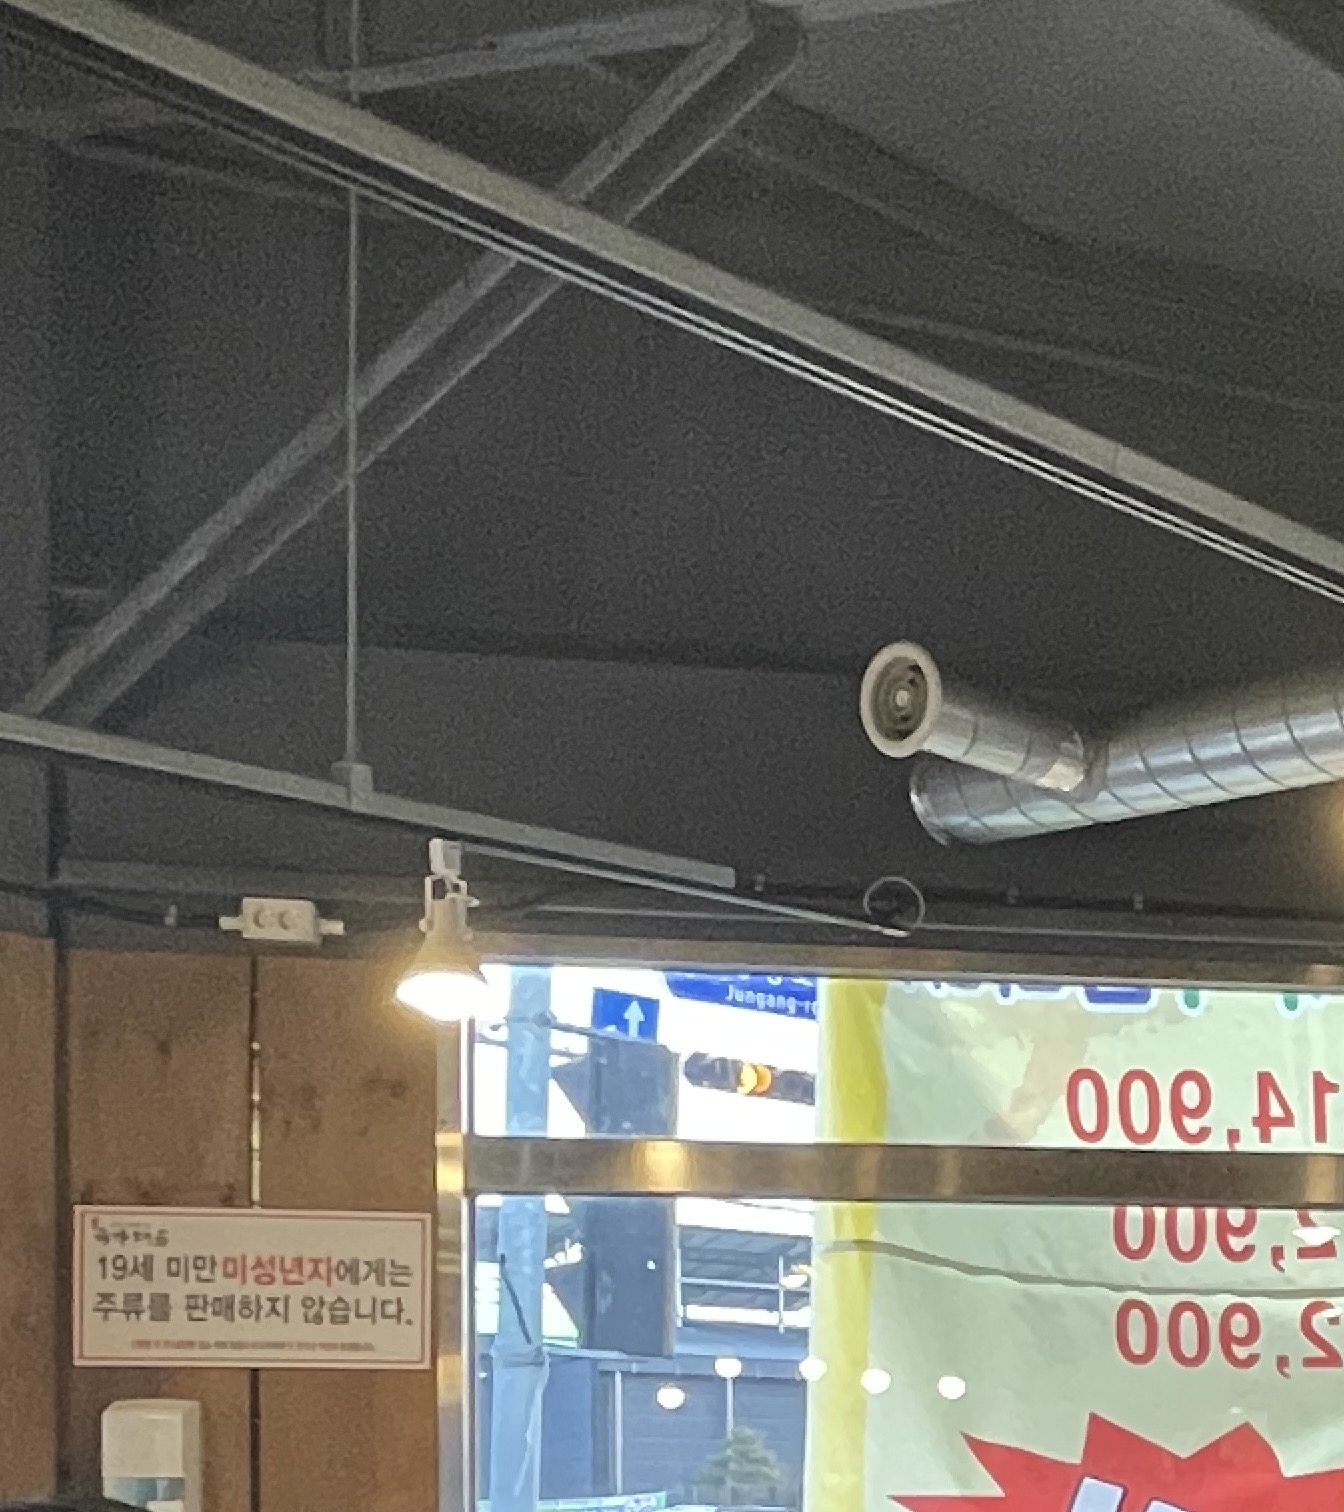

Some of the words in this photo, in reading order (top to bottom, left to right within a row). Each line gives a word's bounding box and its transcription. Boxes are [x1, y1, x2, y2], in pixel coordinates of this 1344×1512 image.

[98, 1254, 154, 1281] 19세
[166, 1254, 217, 1283] 미만
[222, 1254, 413, 1287] 미성년자에게는
[93, 1292, 172, 1321] 주류를
[185, 1294, 291, 1323] 판매하지
[300, 1296, 413, 1325] 않습니다.
